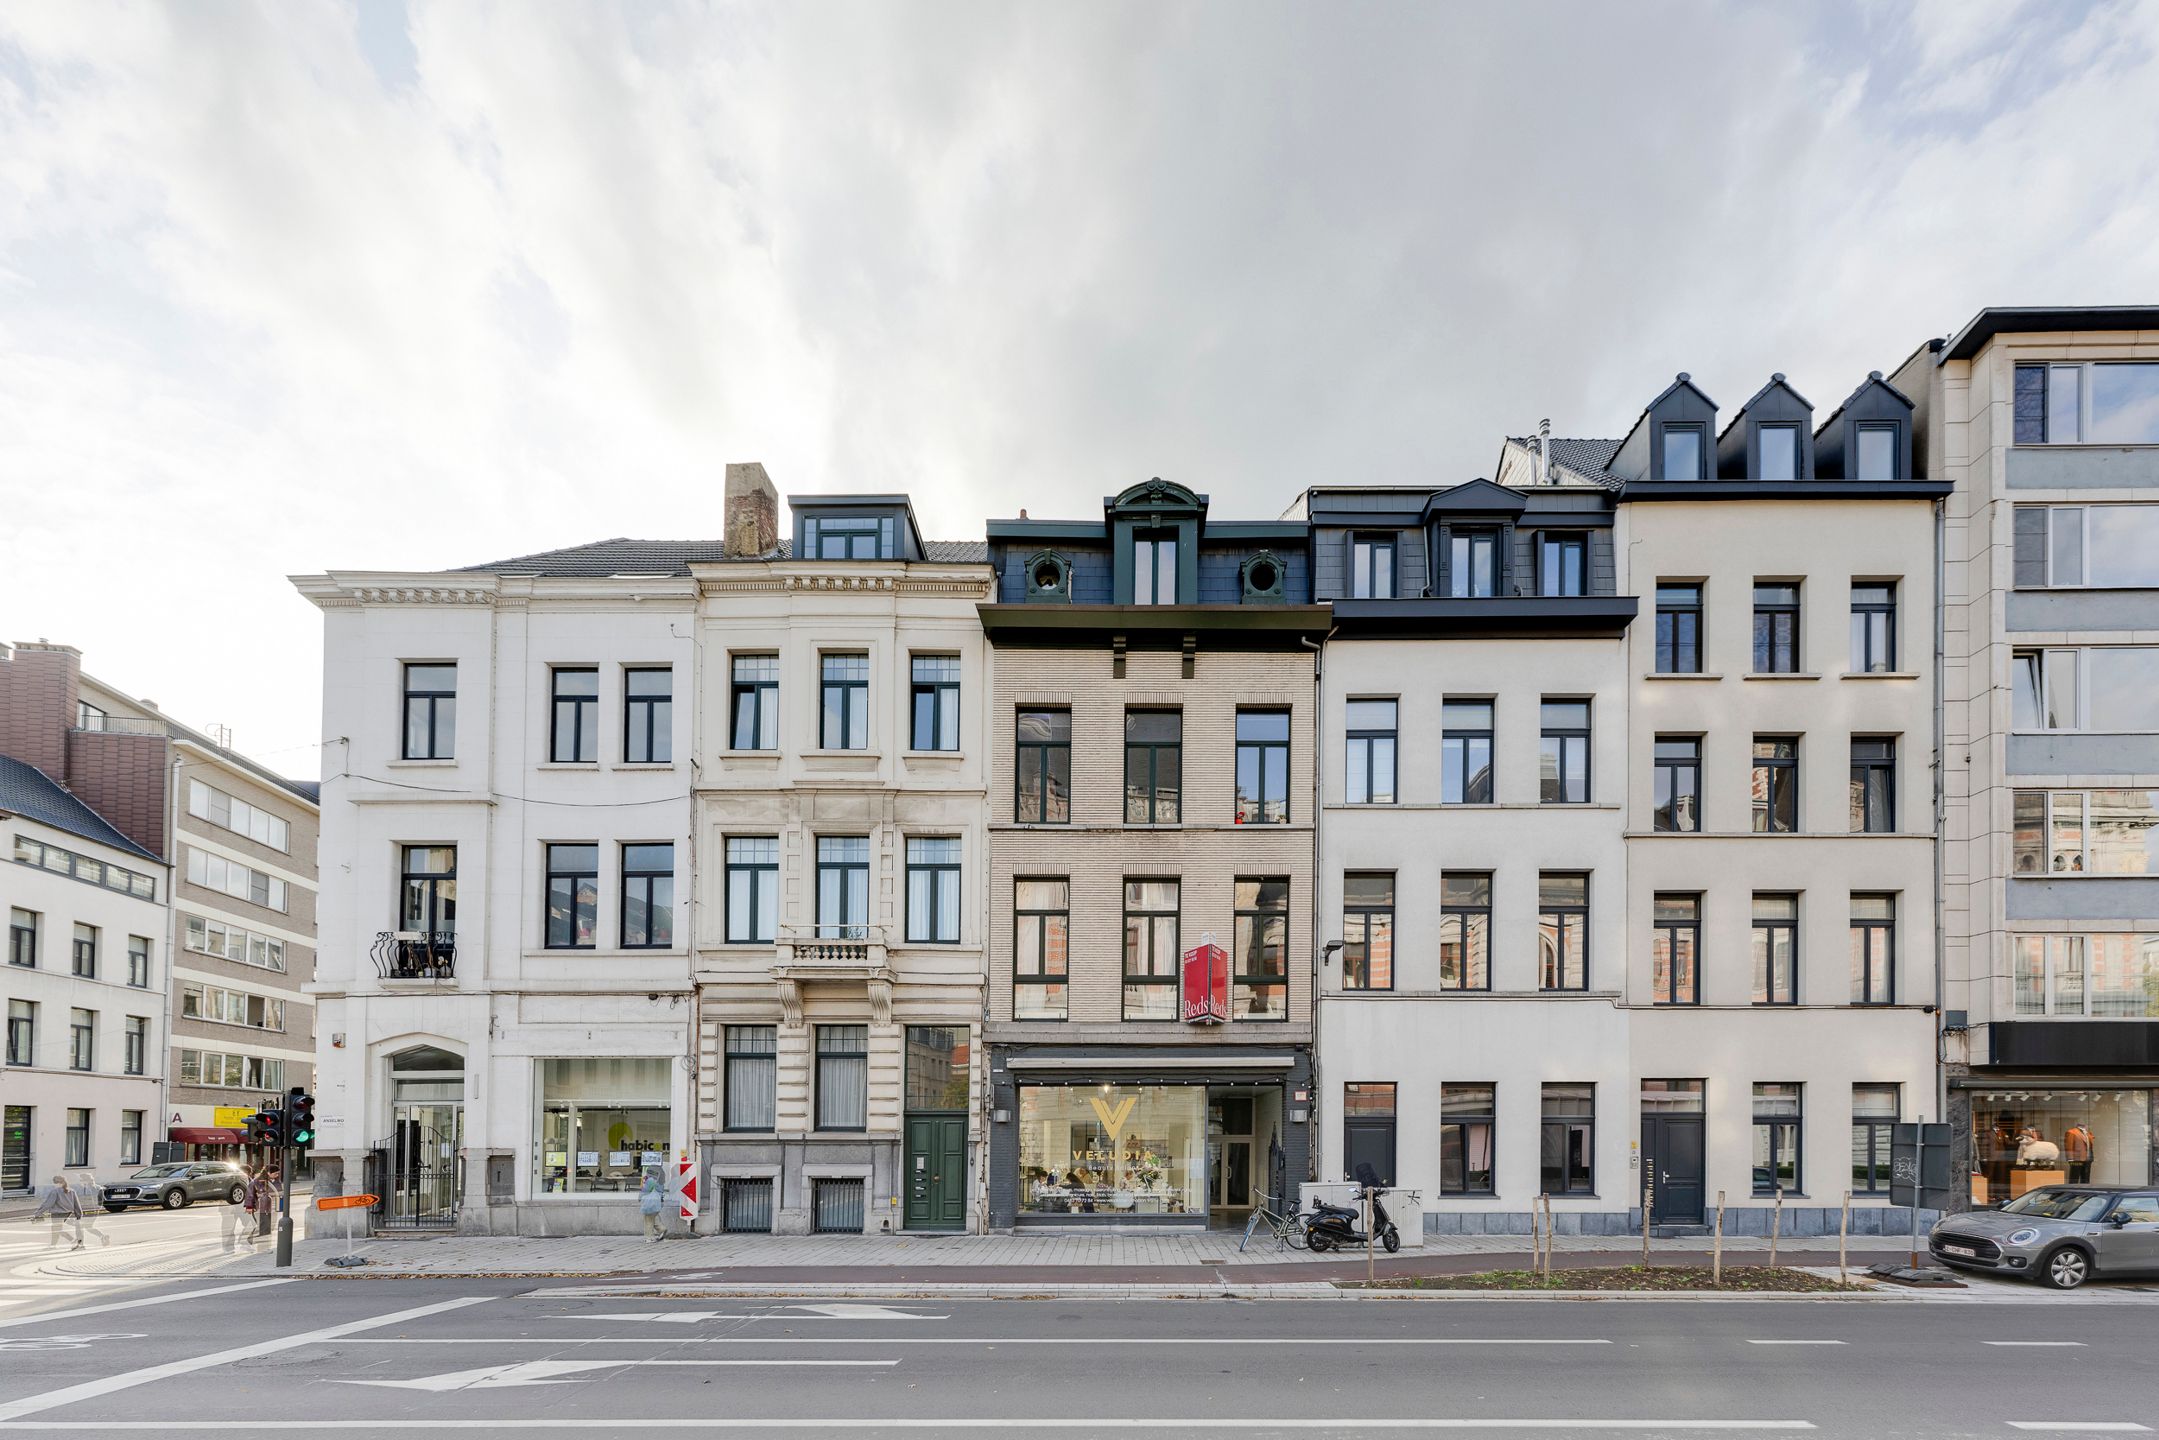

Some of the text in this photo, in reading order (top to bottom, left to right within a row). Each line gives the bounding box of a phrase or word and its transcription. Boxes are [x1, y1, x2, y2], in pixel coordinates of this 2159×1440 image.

[1184, 996, 1208, 1018] Reds
[1211, 995, 1227, 1017] Reds
[620, 1139, 670, 1151] habicon
